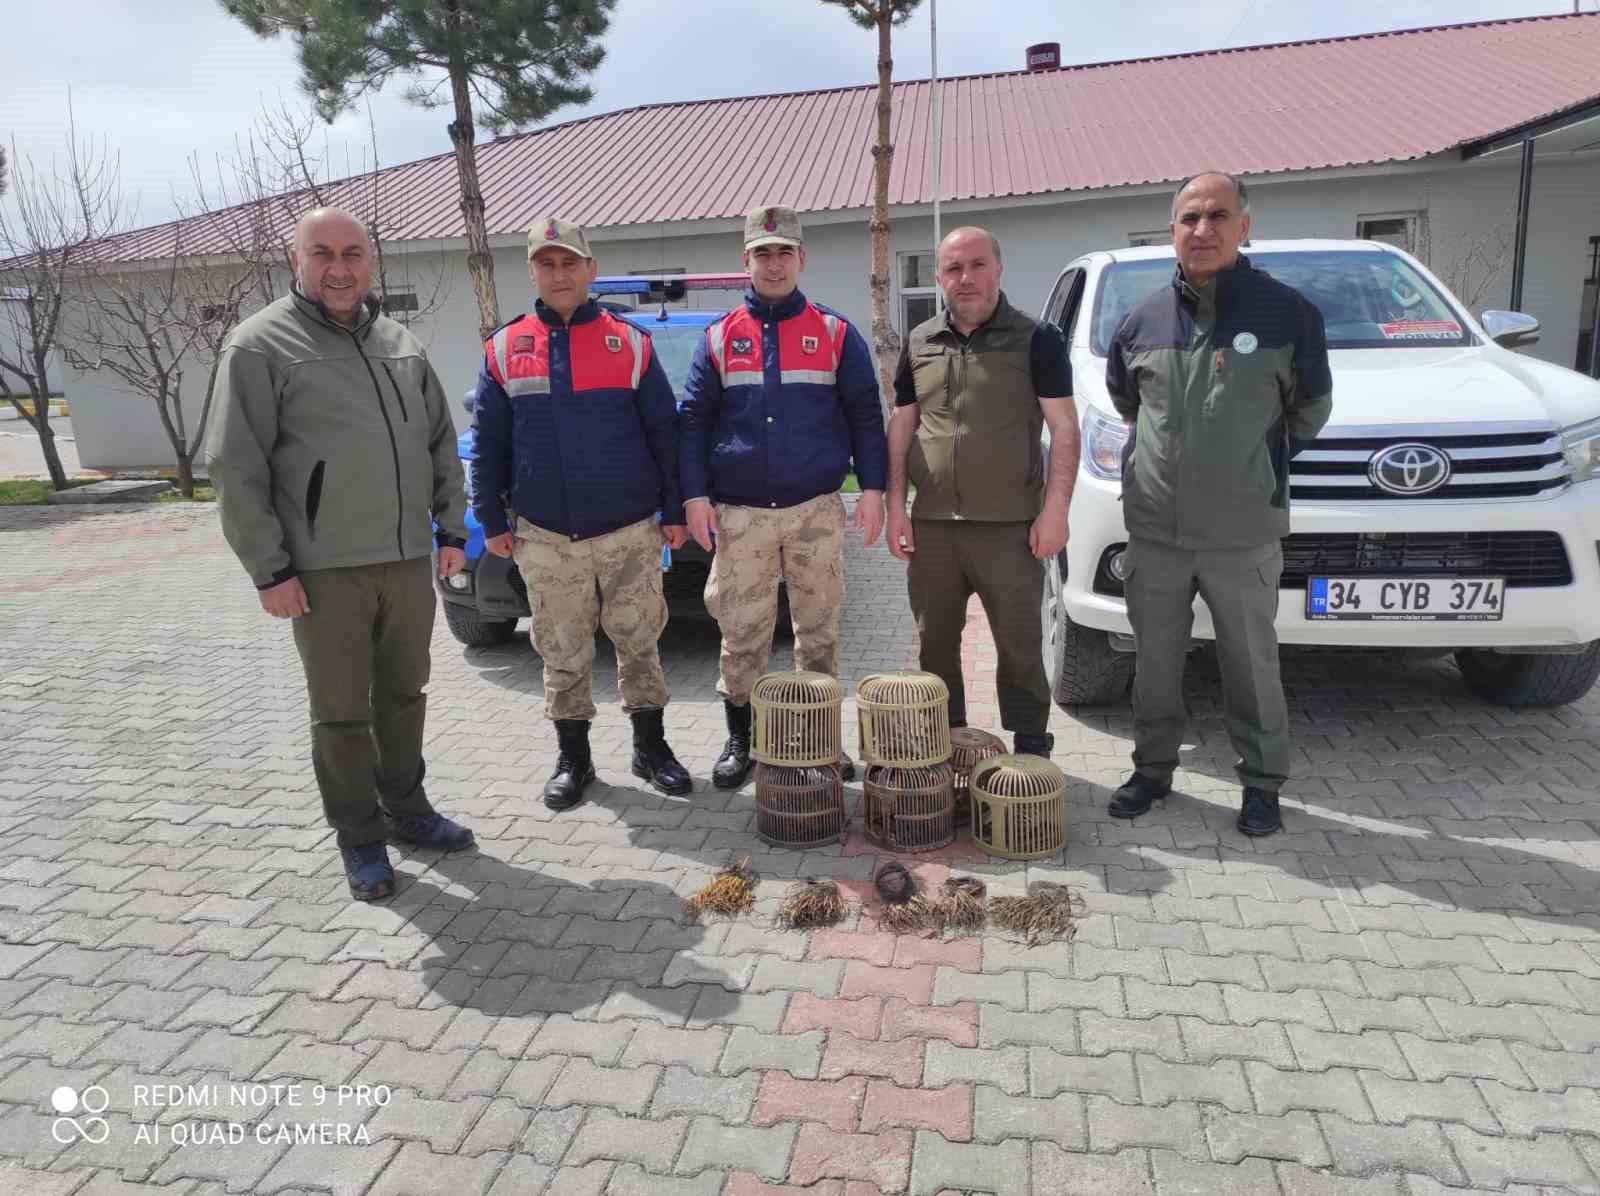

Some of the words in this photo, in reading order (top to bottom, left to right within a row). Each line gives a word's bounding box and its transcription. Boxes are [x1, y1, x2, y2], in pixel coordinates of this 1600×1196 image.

[1314, 597, 1326, 607] TR
[1329, 582, 1361, 610] 34
[1380, 582, 1430, 610] CYB
[1449, 582, 1499, 610] 374
